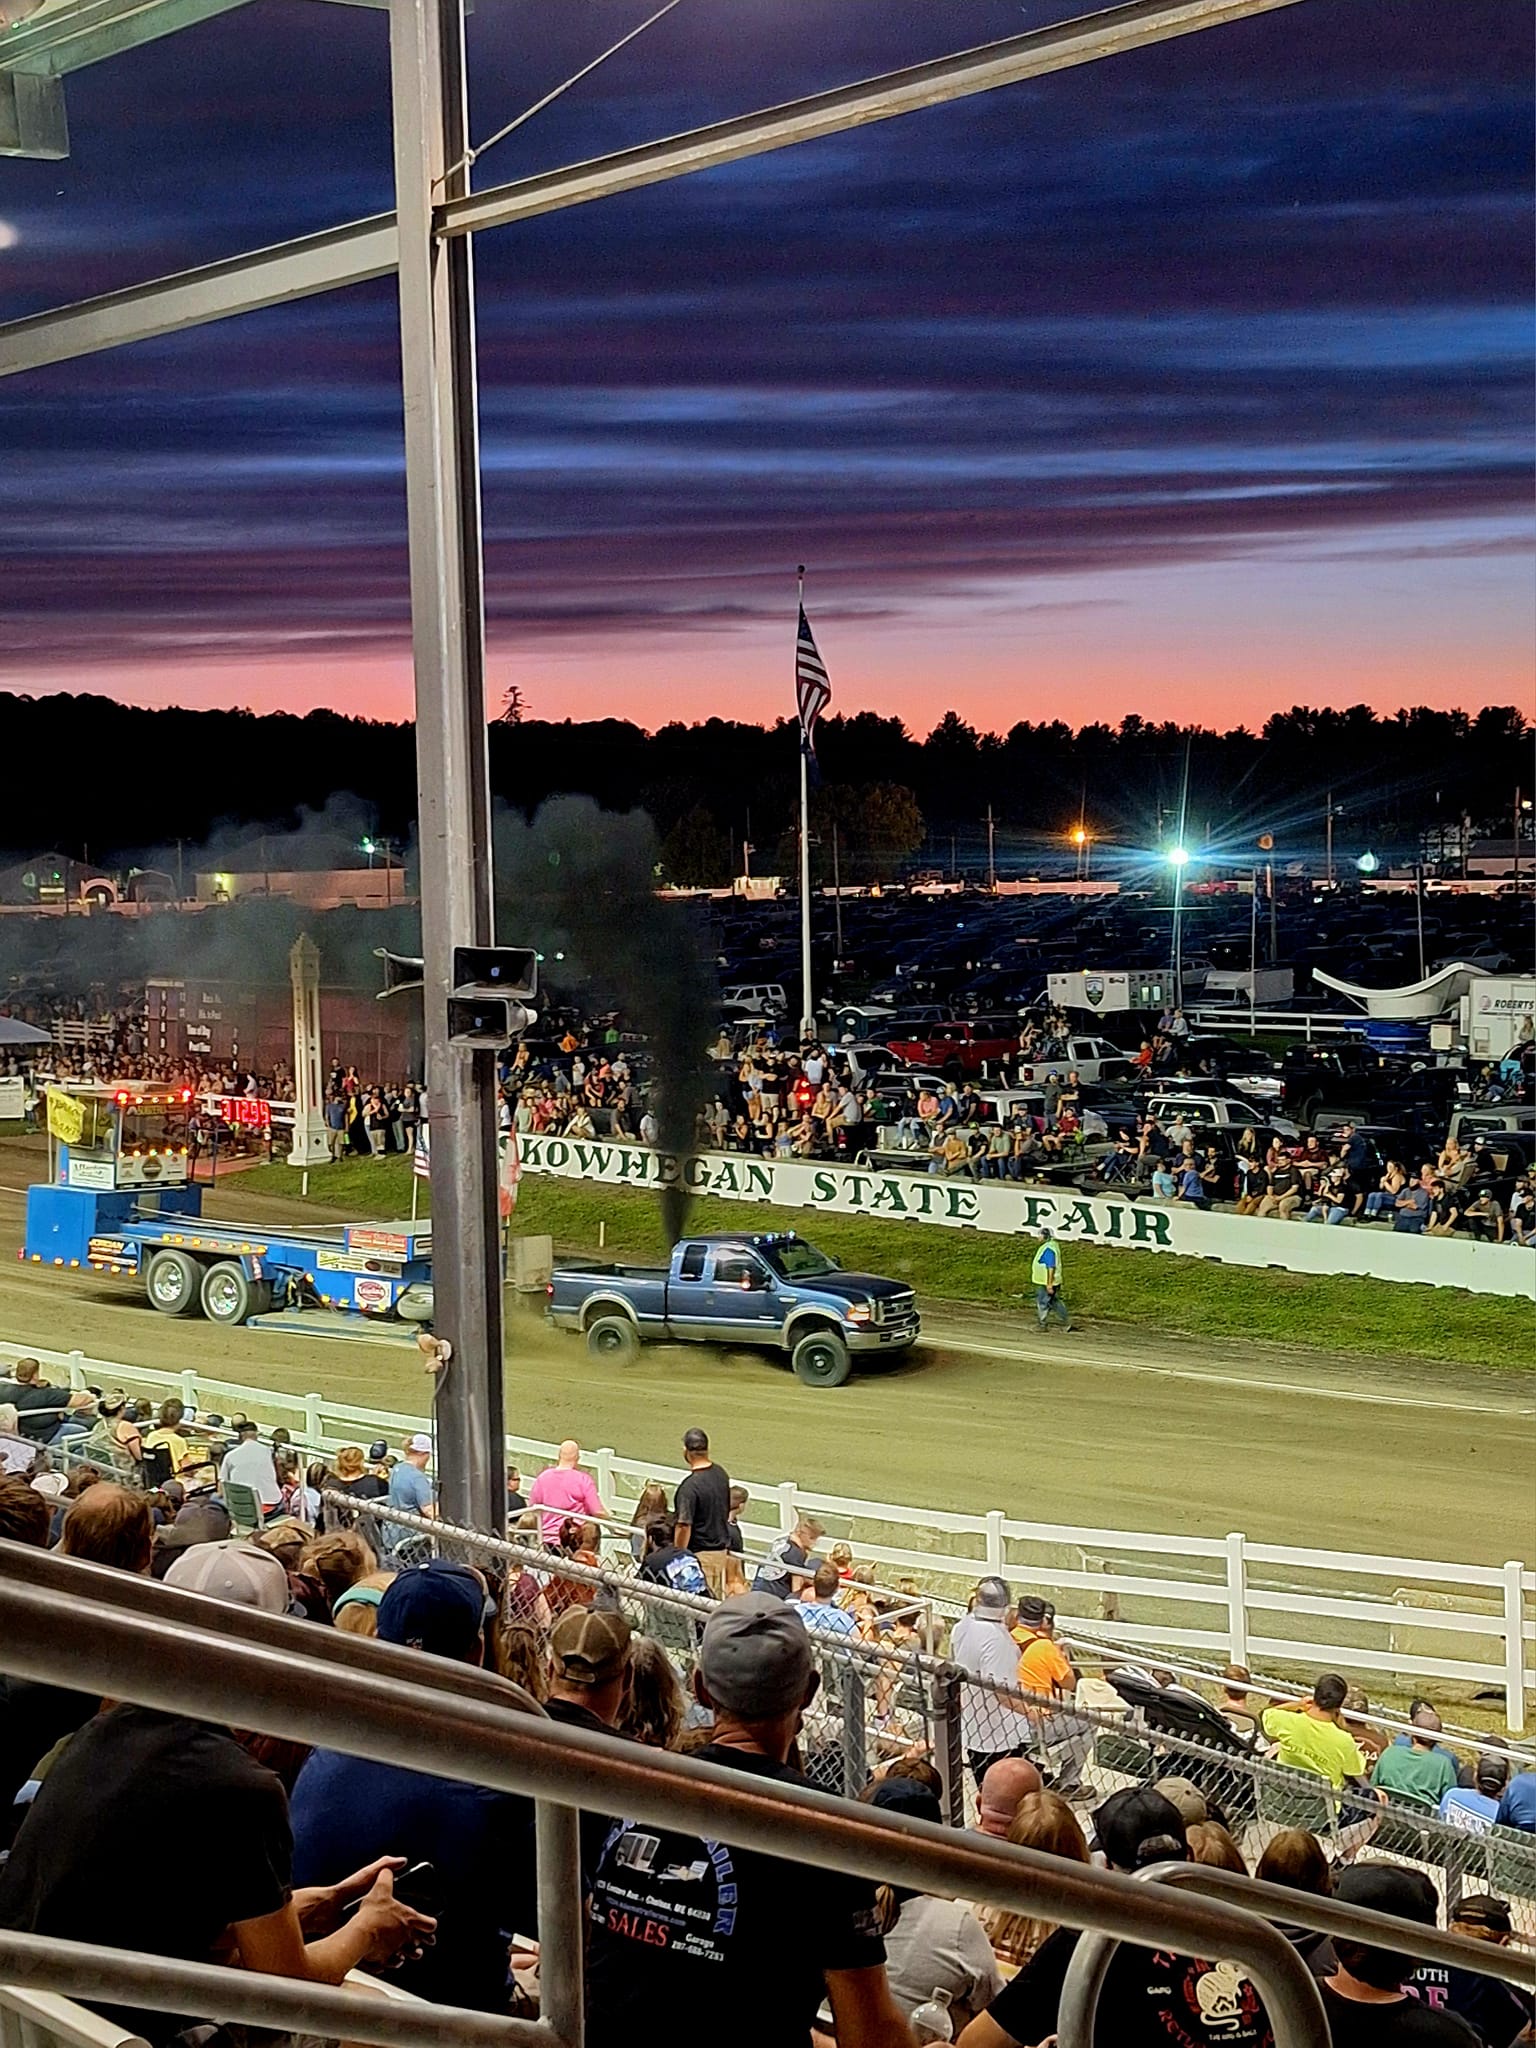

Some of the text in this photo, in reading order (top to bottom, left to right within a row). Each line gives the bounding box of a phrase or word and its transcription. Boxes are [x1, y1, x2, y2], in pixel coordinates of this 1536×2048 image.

[1494, 999, 1535, 1010] ROBERTS
[811, 1171, 981, 1221] STATE
[1023, 1196, 1173, 1246] FAIR
[607, 1908, 670, 1947] SALES
